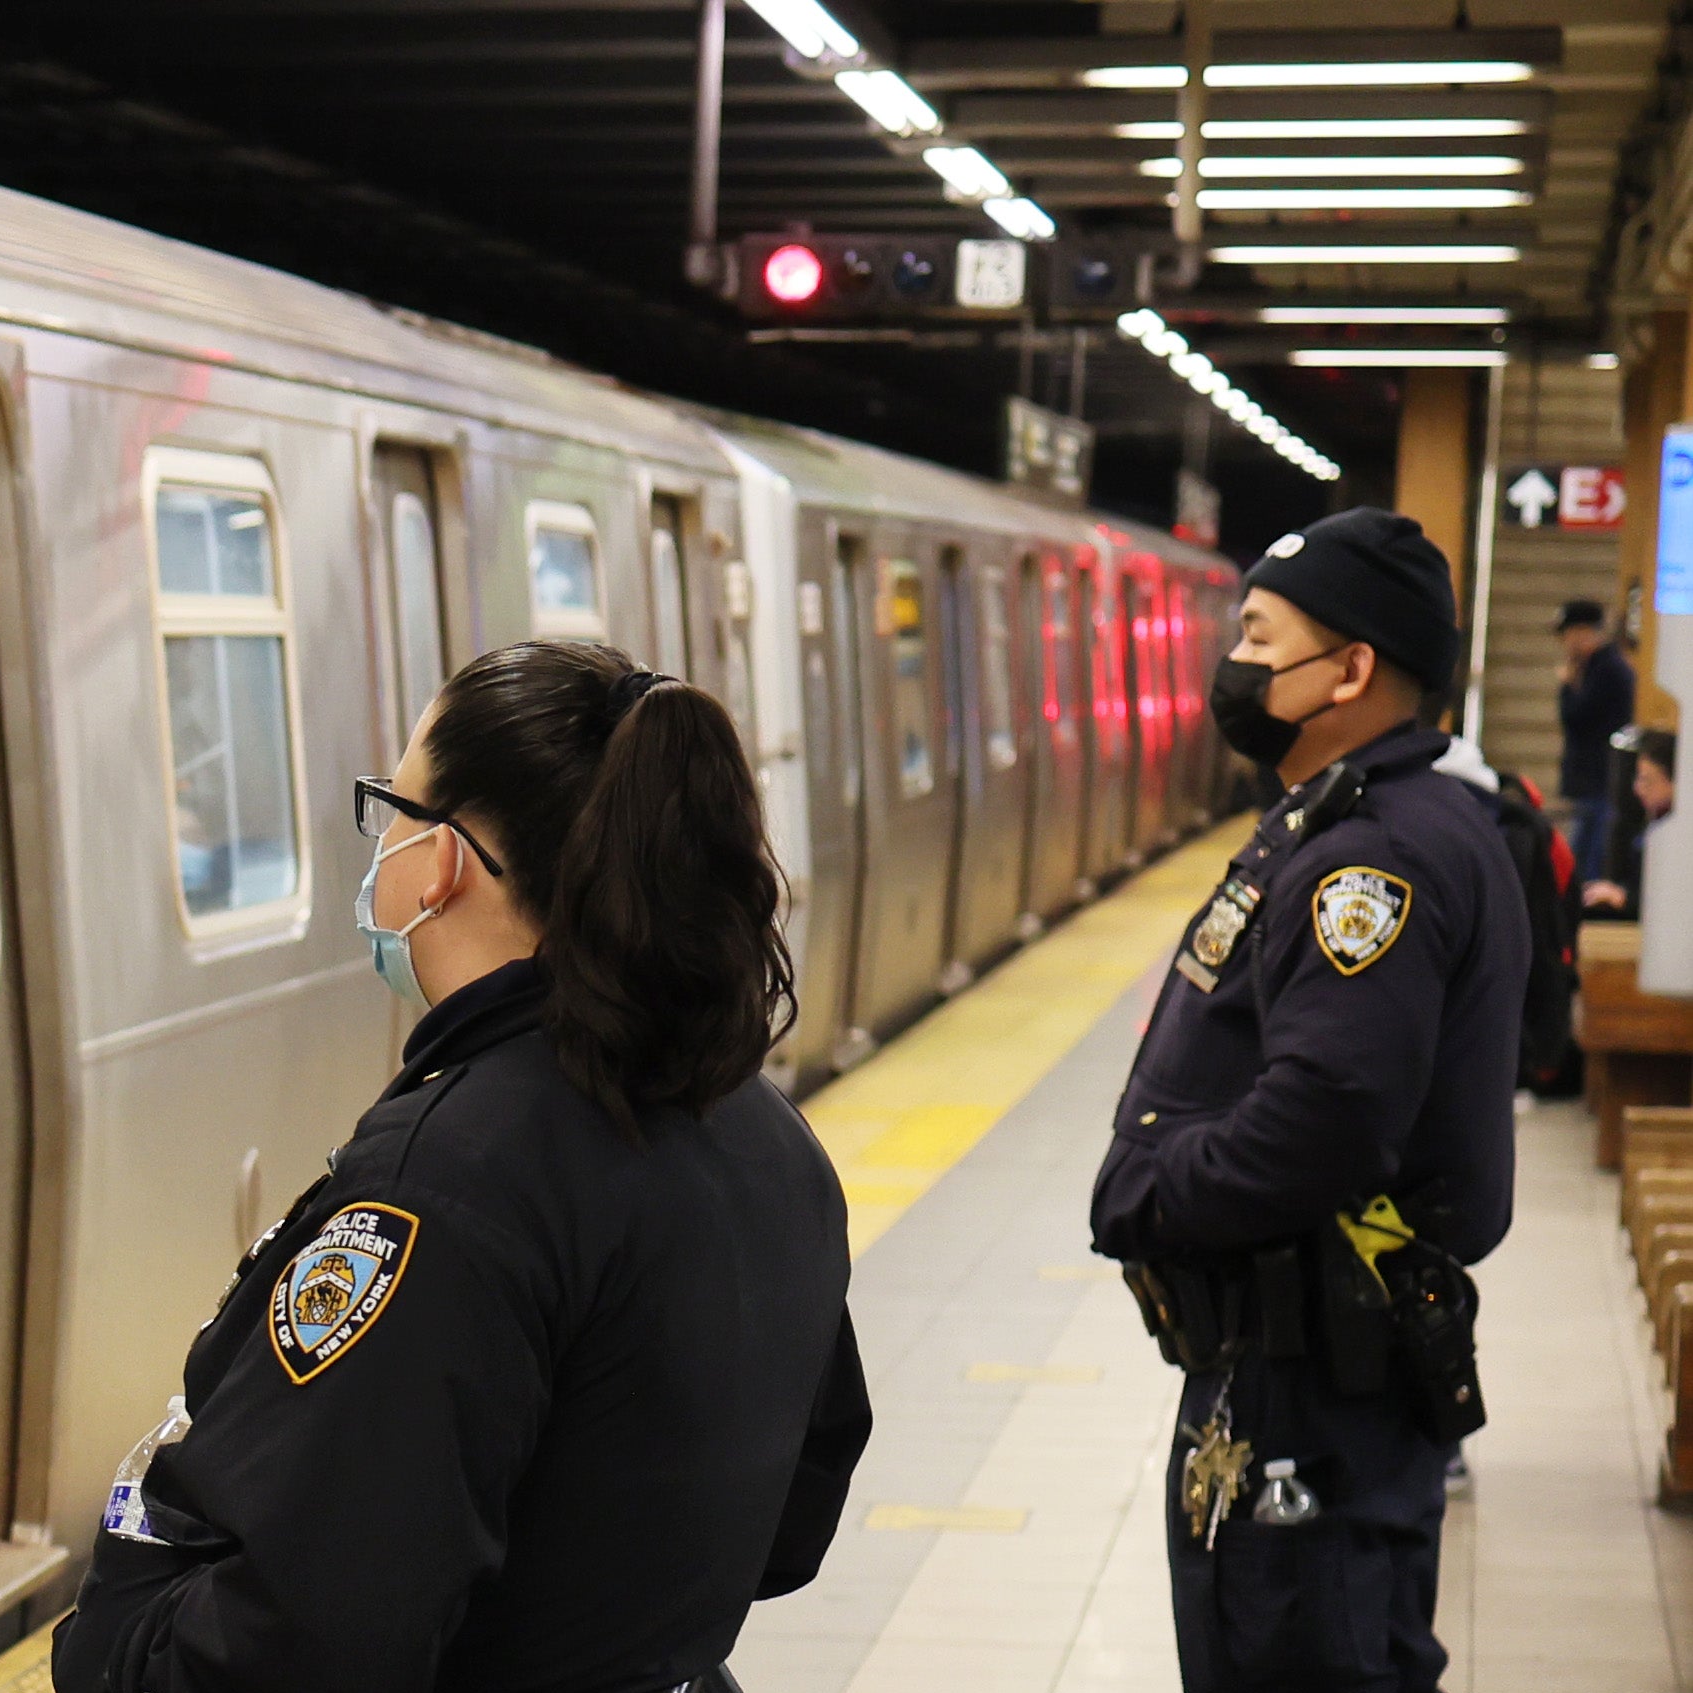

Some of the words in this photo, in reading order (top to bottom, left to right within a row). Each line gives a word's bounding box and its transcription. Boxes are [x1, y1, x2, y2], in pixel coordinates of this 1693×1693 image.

[322, 1212, 380, 1236] POLICE
[295, 1229, 398, 1261] DEPARTMENT
[275, 1282, 288, 1322] CITY
[315, 1323, 353, 1360] NEW
[350, 1272, 394, 1322] YORK
[278, 1324, 294, 1349] OF
